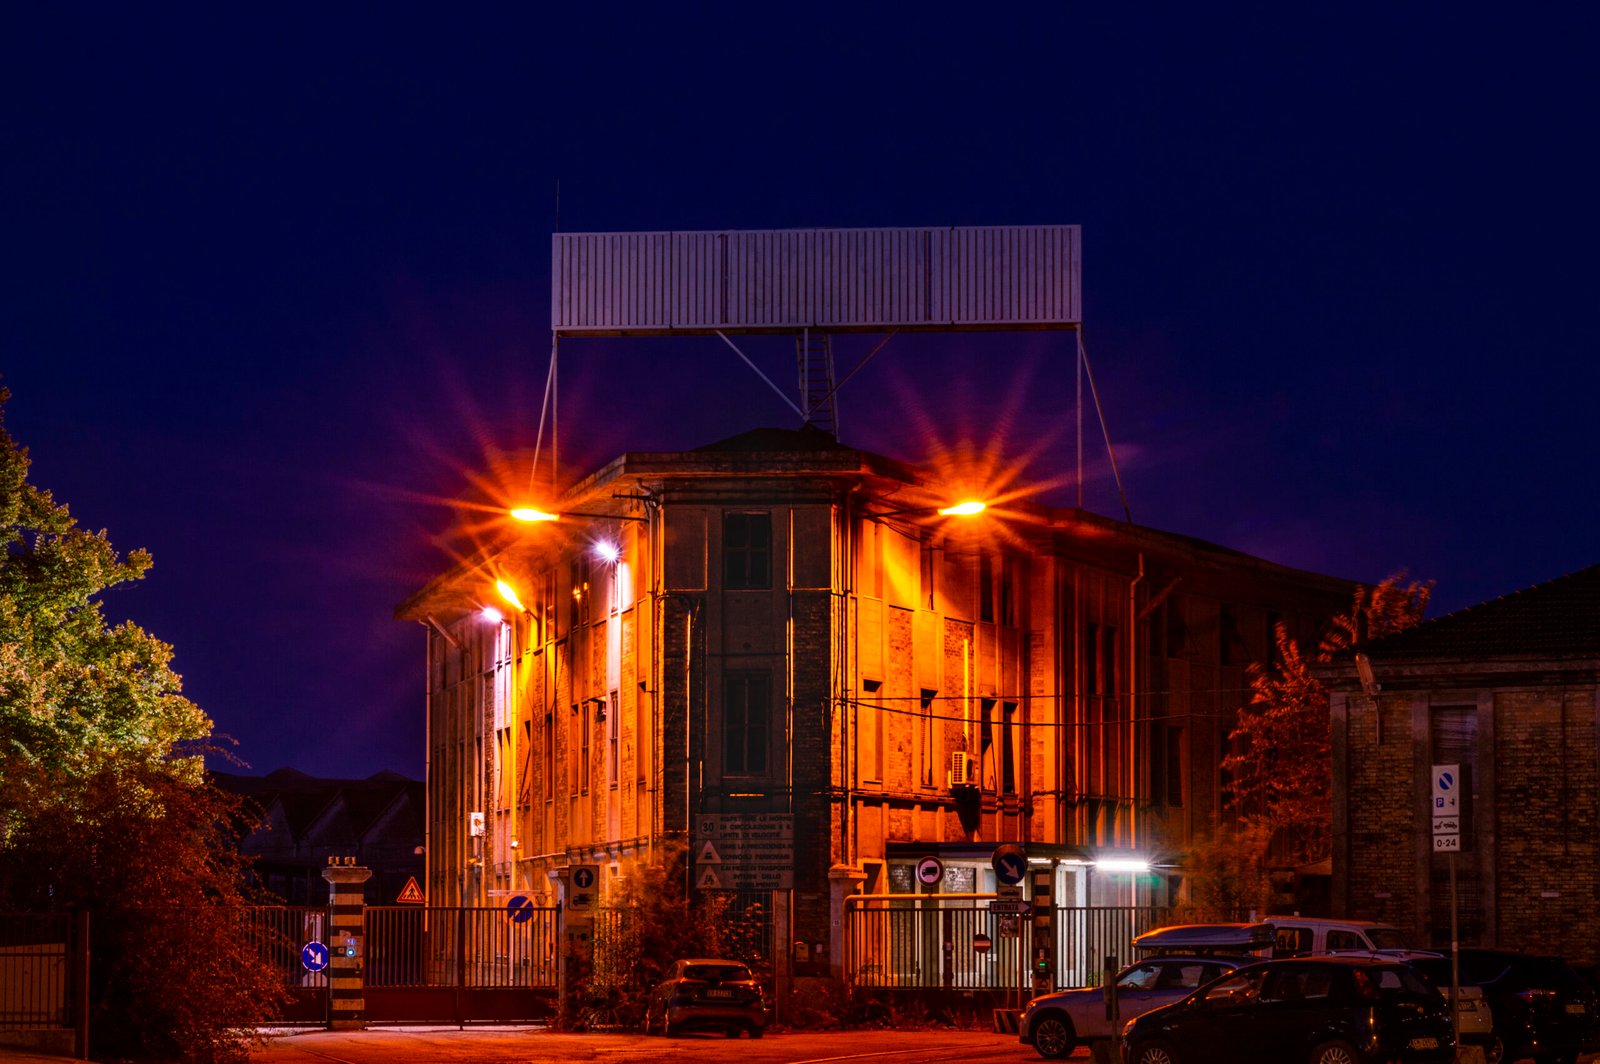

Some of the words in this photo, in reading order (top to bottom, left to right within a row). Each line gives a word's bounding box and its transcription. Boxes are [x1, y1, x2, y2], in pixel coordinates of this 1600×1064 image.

[702, 822, 714, 832] 30
[1437, 839, 1456, 847] 0-24
[993, 903, 1019, 911] ENTRATA
